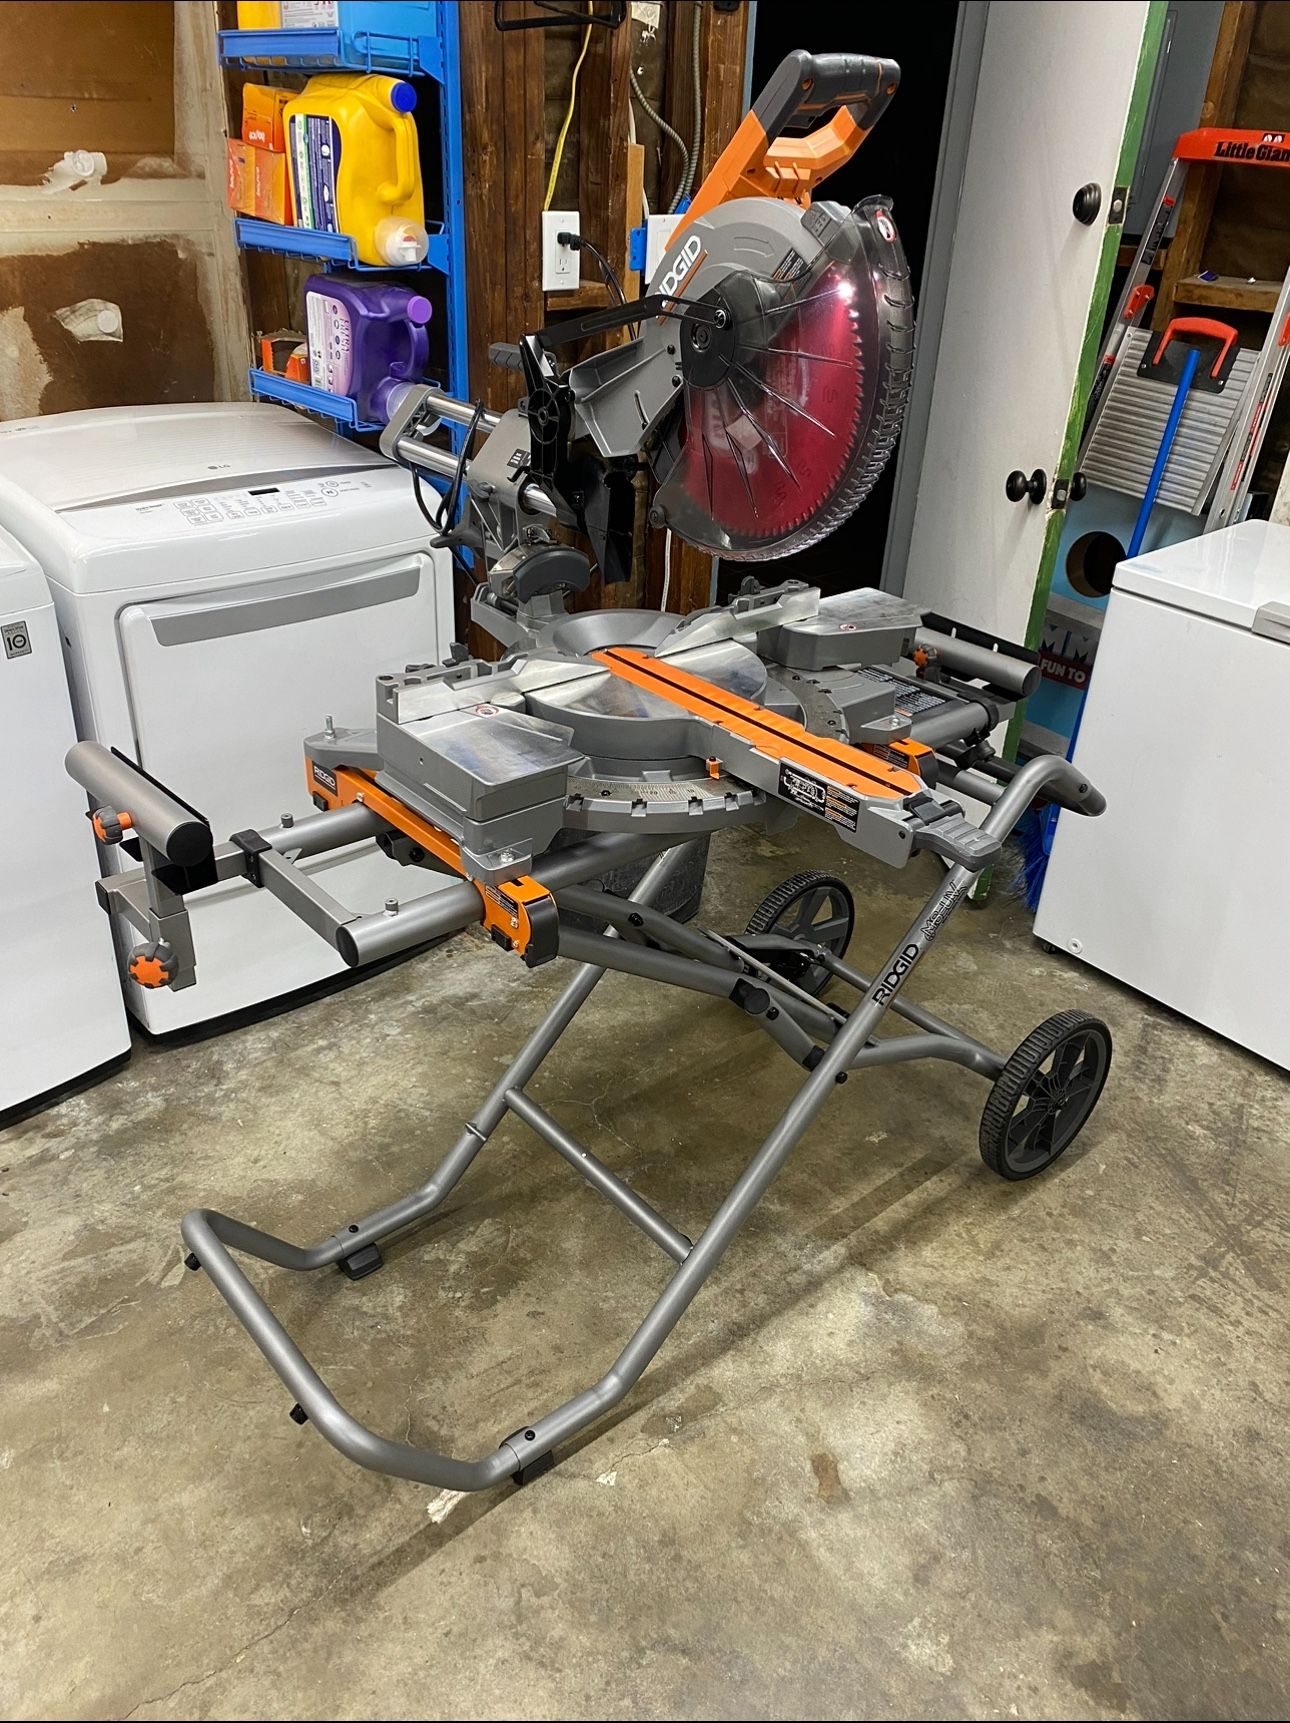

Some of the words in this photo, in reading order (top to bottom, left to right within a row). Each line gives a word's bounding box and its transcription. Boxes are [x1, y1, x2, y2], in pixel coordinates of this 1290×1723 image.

[654, 235, 702, 297] IDGID
[1040, 658, 1067, 677] FUN
[1068, 667, 1086, 683] TO
[871, 943, 920, 1006] RIDGID
